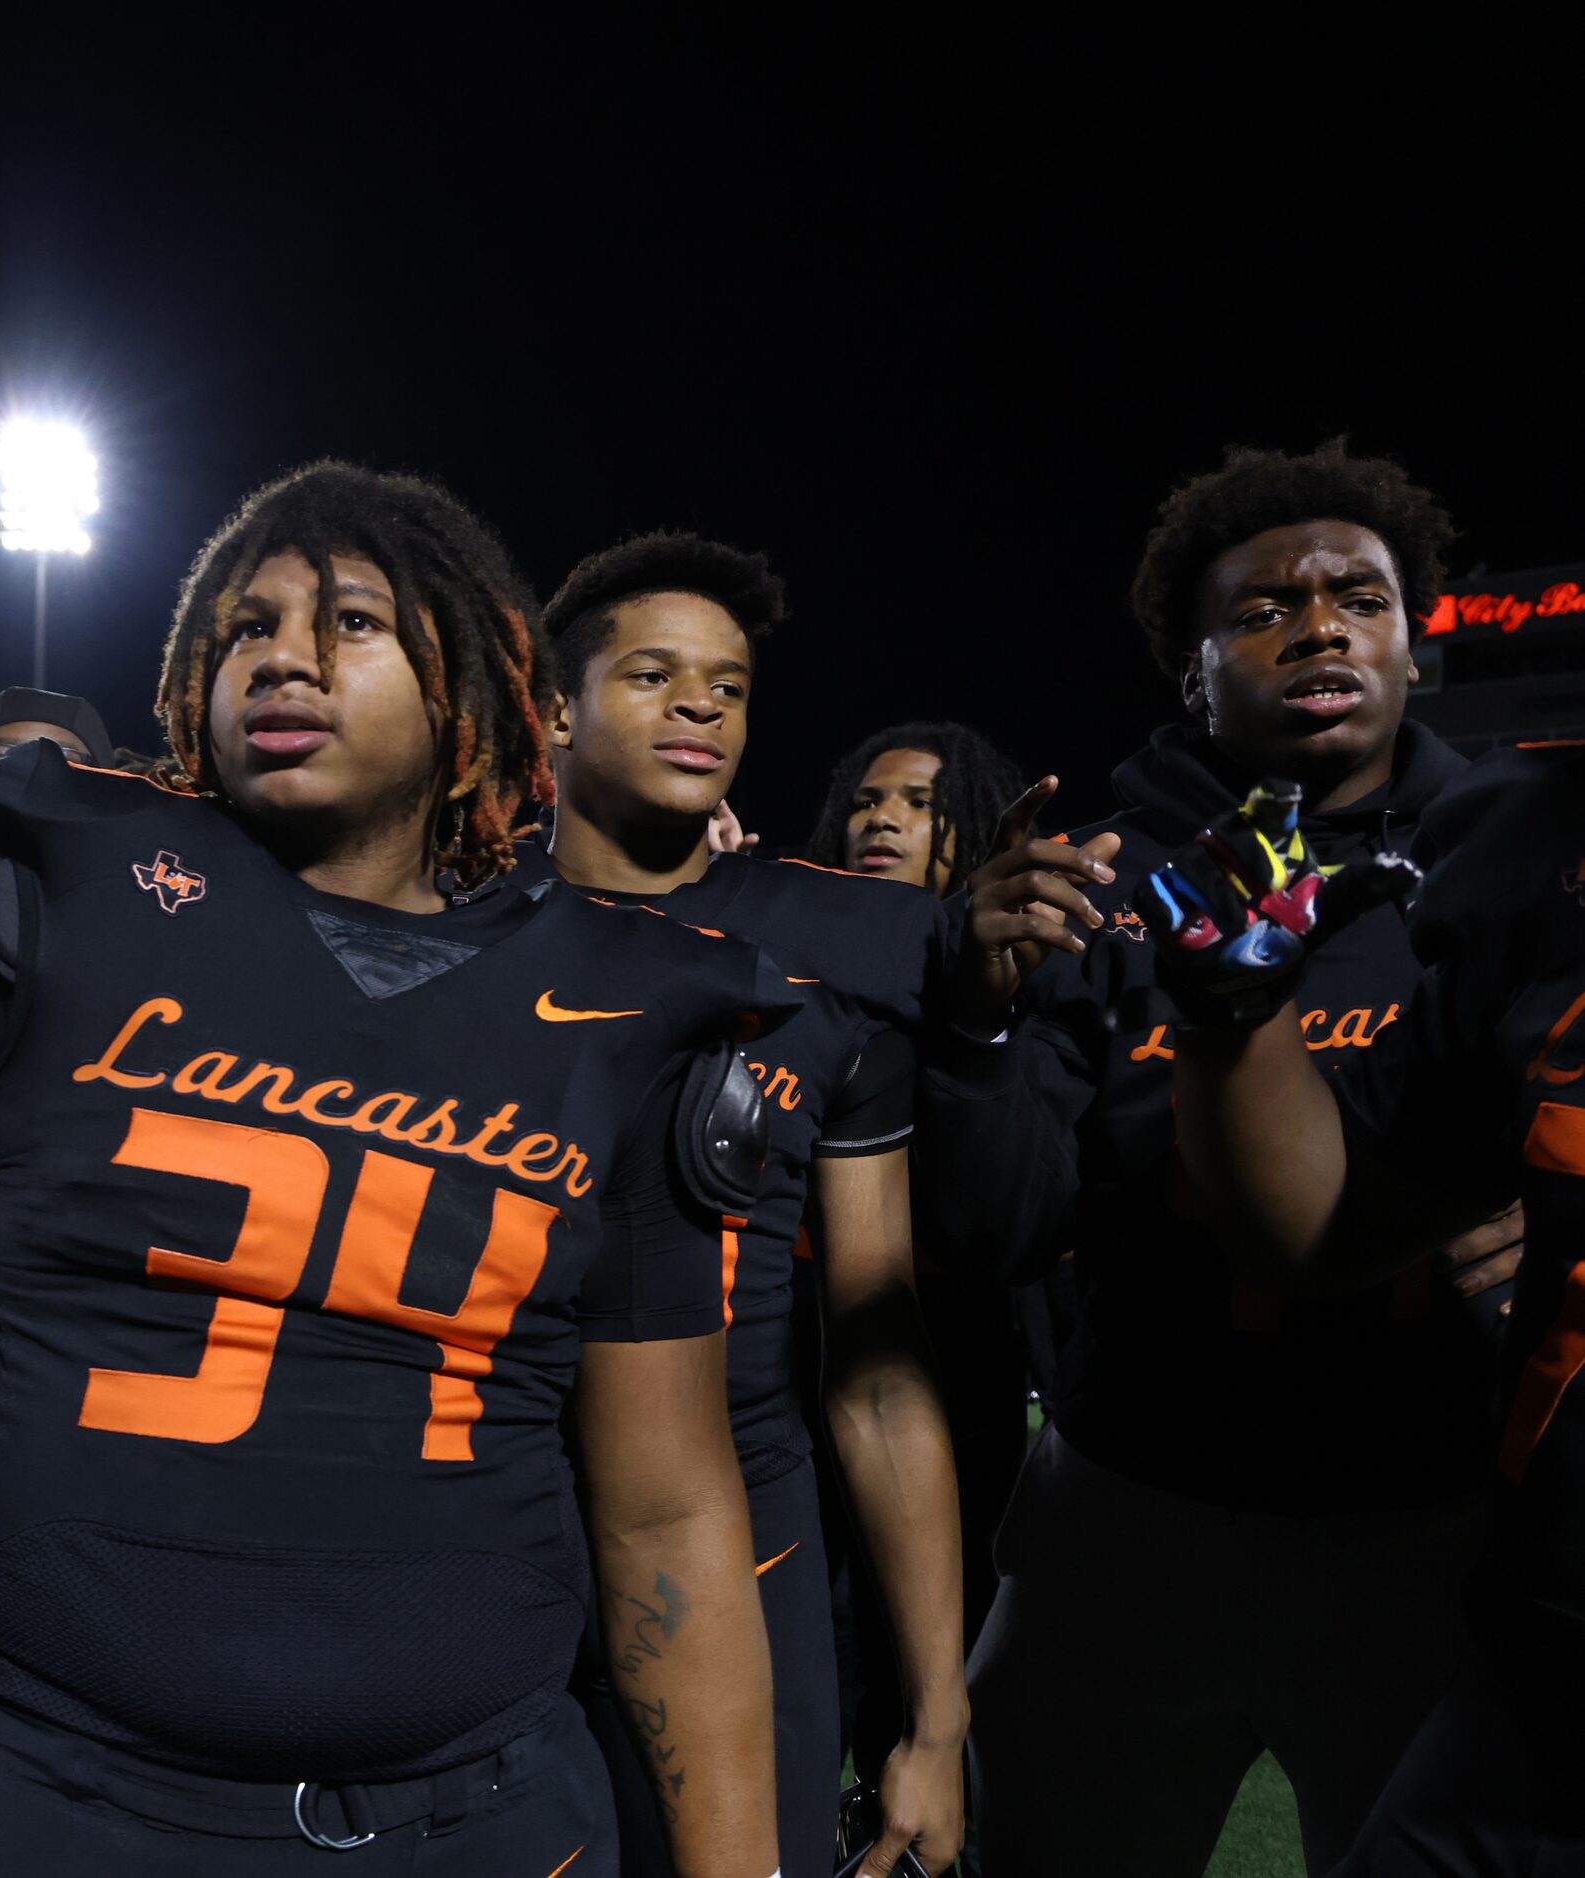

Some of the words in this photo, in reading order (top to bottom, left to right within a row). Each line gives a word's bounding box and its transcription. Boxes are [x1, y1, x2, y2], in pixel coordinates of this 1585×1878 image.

[1458, 593, 1533, 635] City
[74, 997, 594, 1197] Lancaster
[77, 1107, 561, 1462] 34
